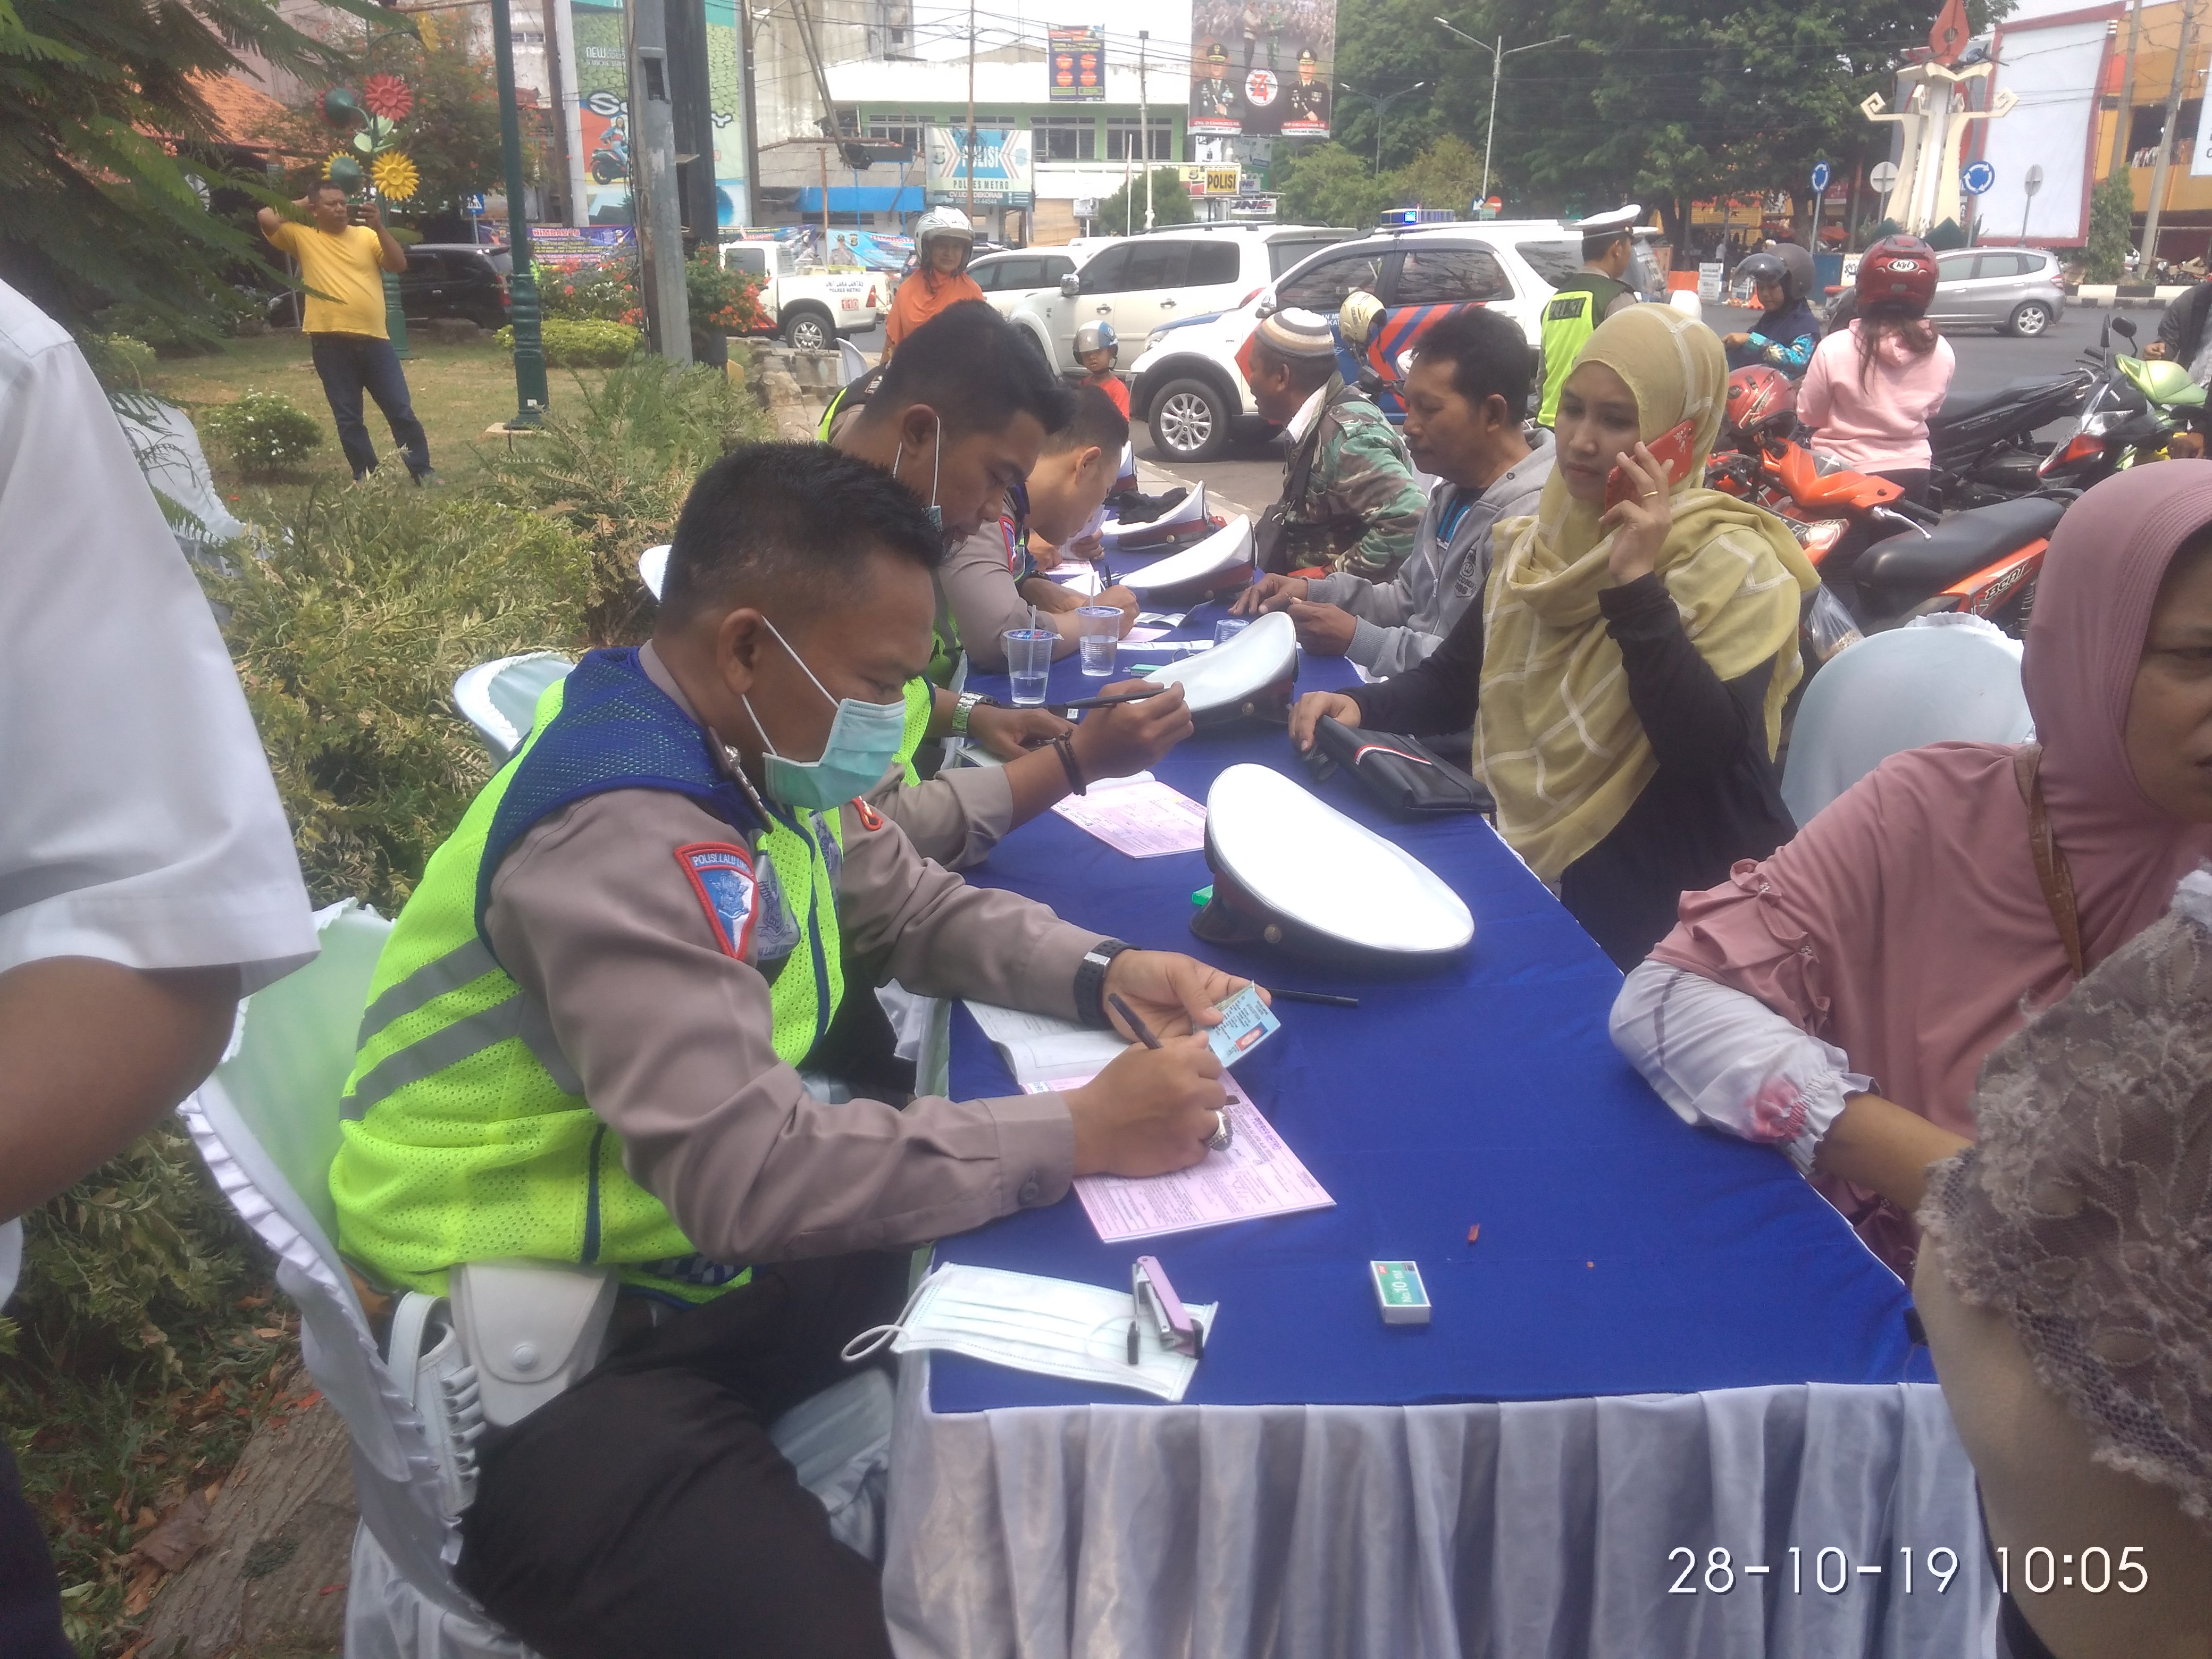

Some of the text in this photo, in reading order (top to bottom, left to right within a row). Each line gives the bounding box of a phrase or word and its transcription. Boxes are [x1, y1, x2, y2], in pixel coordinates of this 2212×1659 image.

[586, 47, 606, 58] NEW
[953, 180, 1009, 189] POLES METRO
[1208, 174, 1236, 189] POLISI
[1231, 200, 1272, 210] JNE
[532, 228, 580, 237] HIMBAUAN
[870, 234, 915, 244] HIMBAU
[842, 299, 858, 309] 110
[692, 852, 717, 866] POLISI
[720, 853, 735, 865] LALU
